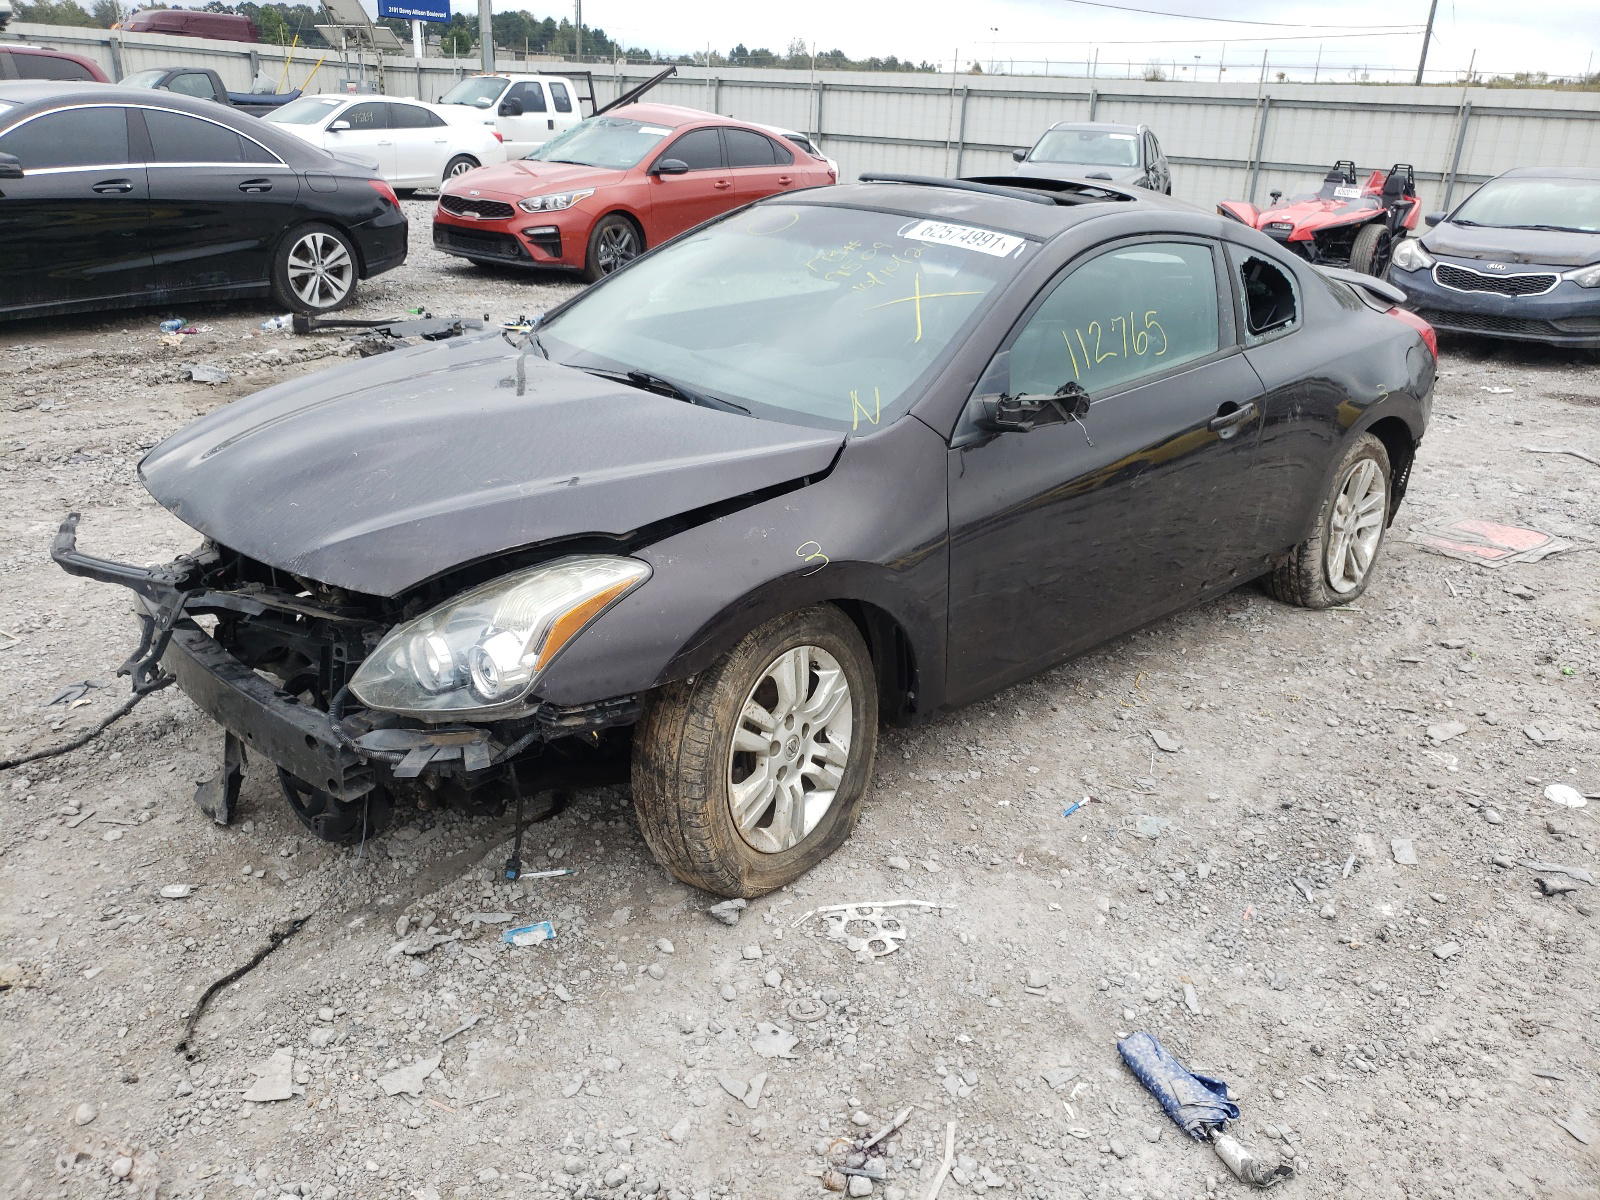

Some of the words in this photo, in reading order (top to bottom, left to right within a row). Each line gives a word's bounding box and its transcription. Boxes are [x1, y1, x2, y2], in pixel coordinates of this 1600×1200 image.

[920, 223, 1005, 250] 62574991
[1061, 309, 1168, 381] 112765
[849, 386, 880, 431] N
[795, 540, 830, 577] 3
